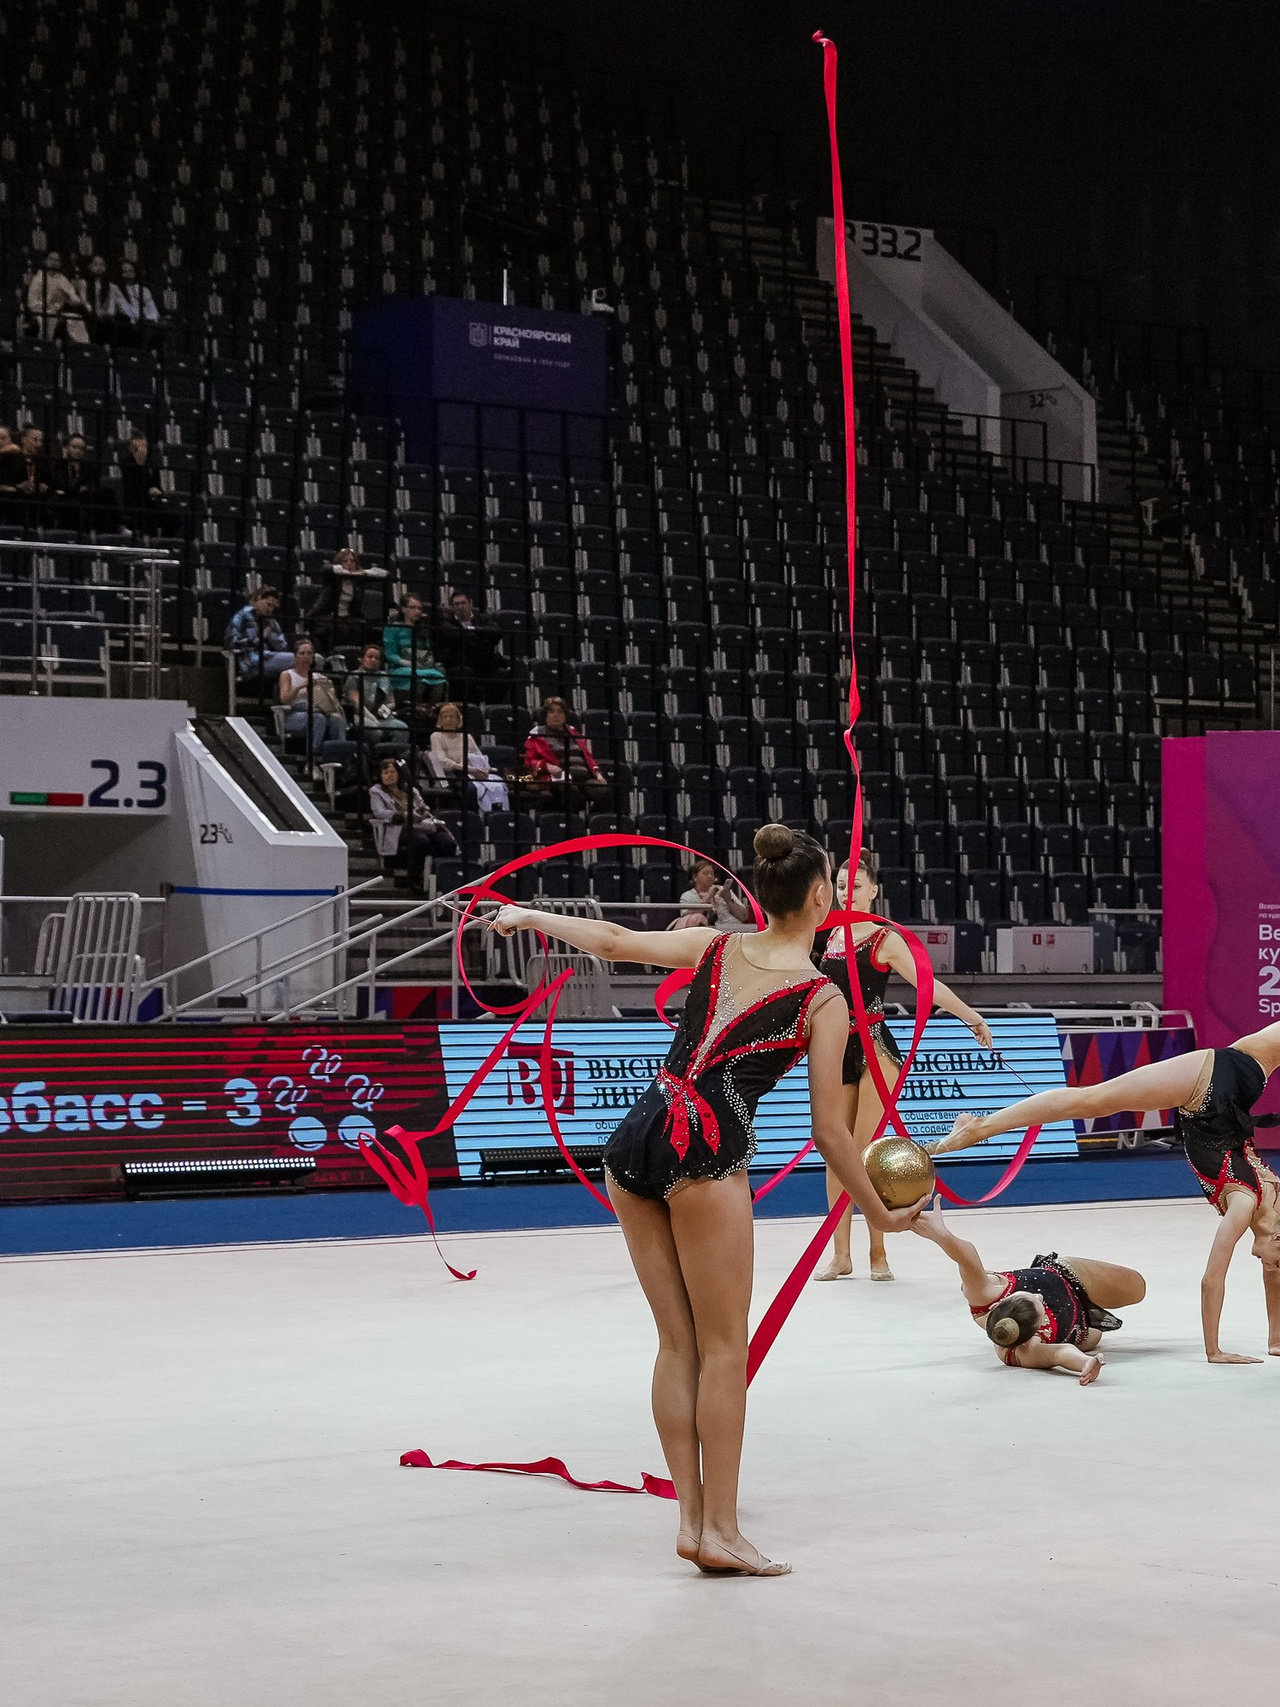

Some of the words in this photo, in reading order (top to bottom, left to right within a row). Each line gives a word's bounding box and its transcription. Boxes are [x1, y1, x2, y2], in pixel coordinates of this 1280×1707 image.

[861, 223, 921, 262] 33.2
[494, 337, 519, 348] КРАЙ
[88, 759, 167, 808] 2.3
[200, 823, 218, 843] 23
[901, 1052, 1005, 1072] ЫСШАЯ
[224, 1077, 262, 1127] 3
